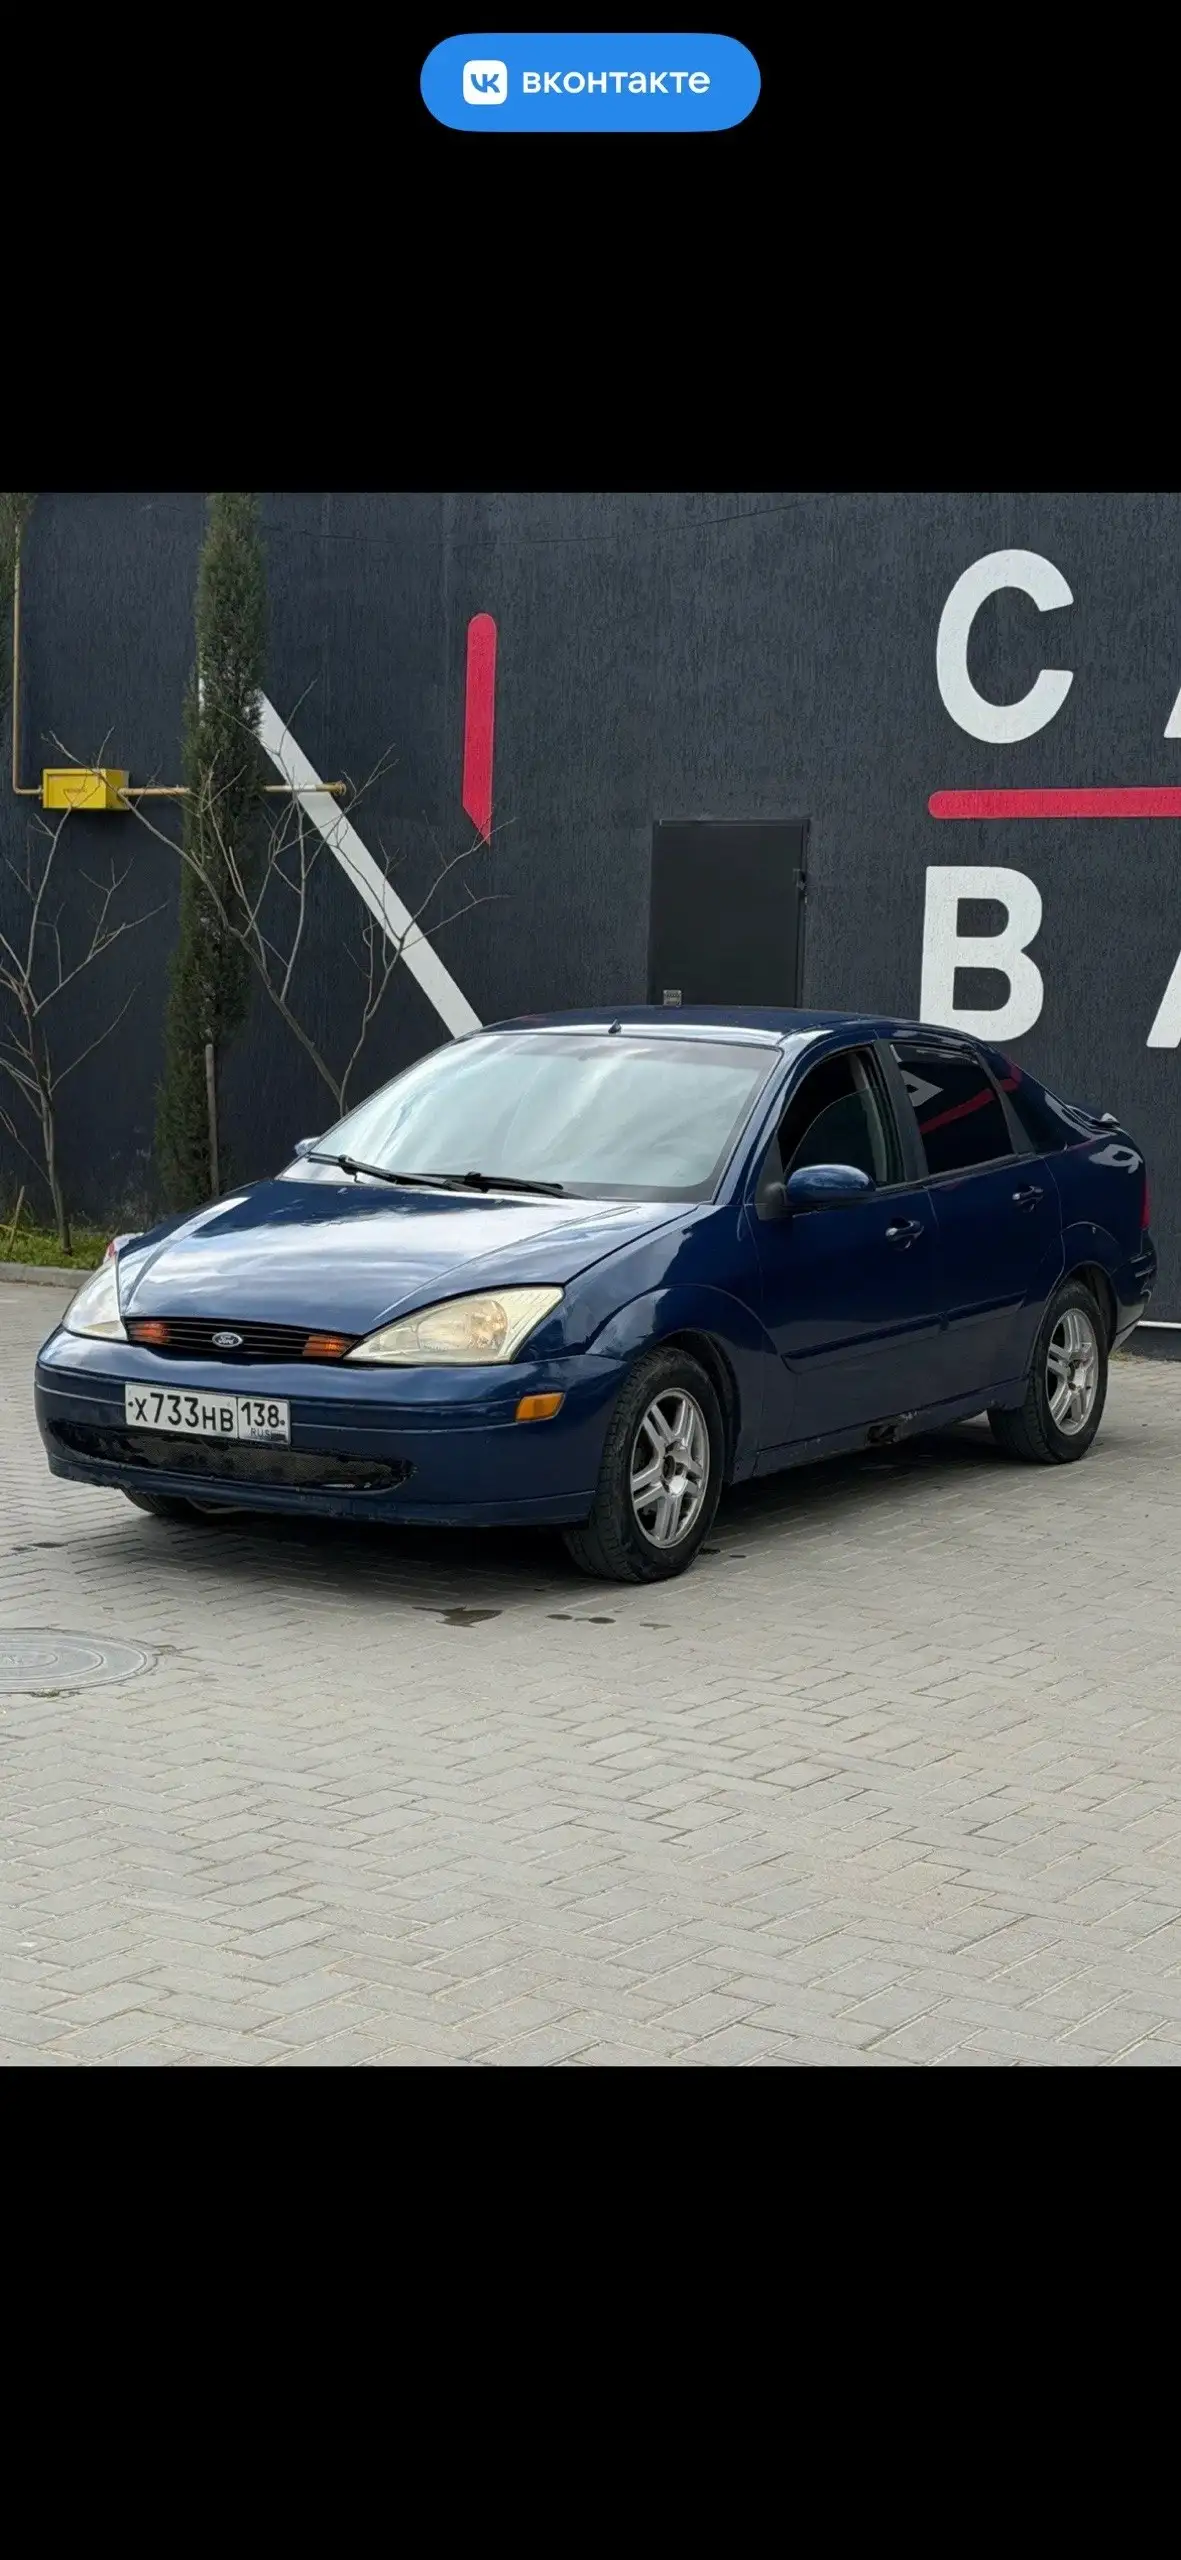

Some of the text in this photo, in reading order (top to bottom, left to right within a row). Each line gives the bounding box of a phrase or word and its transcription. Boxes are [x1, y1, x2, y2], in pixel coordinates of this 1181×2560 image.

[936, 548, 1181, 744] C
[240, 1401, 280, 1428] 138
[250, 1427, 272, 1438] RUS
